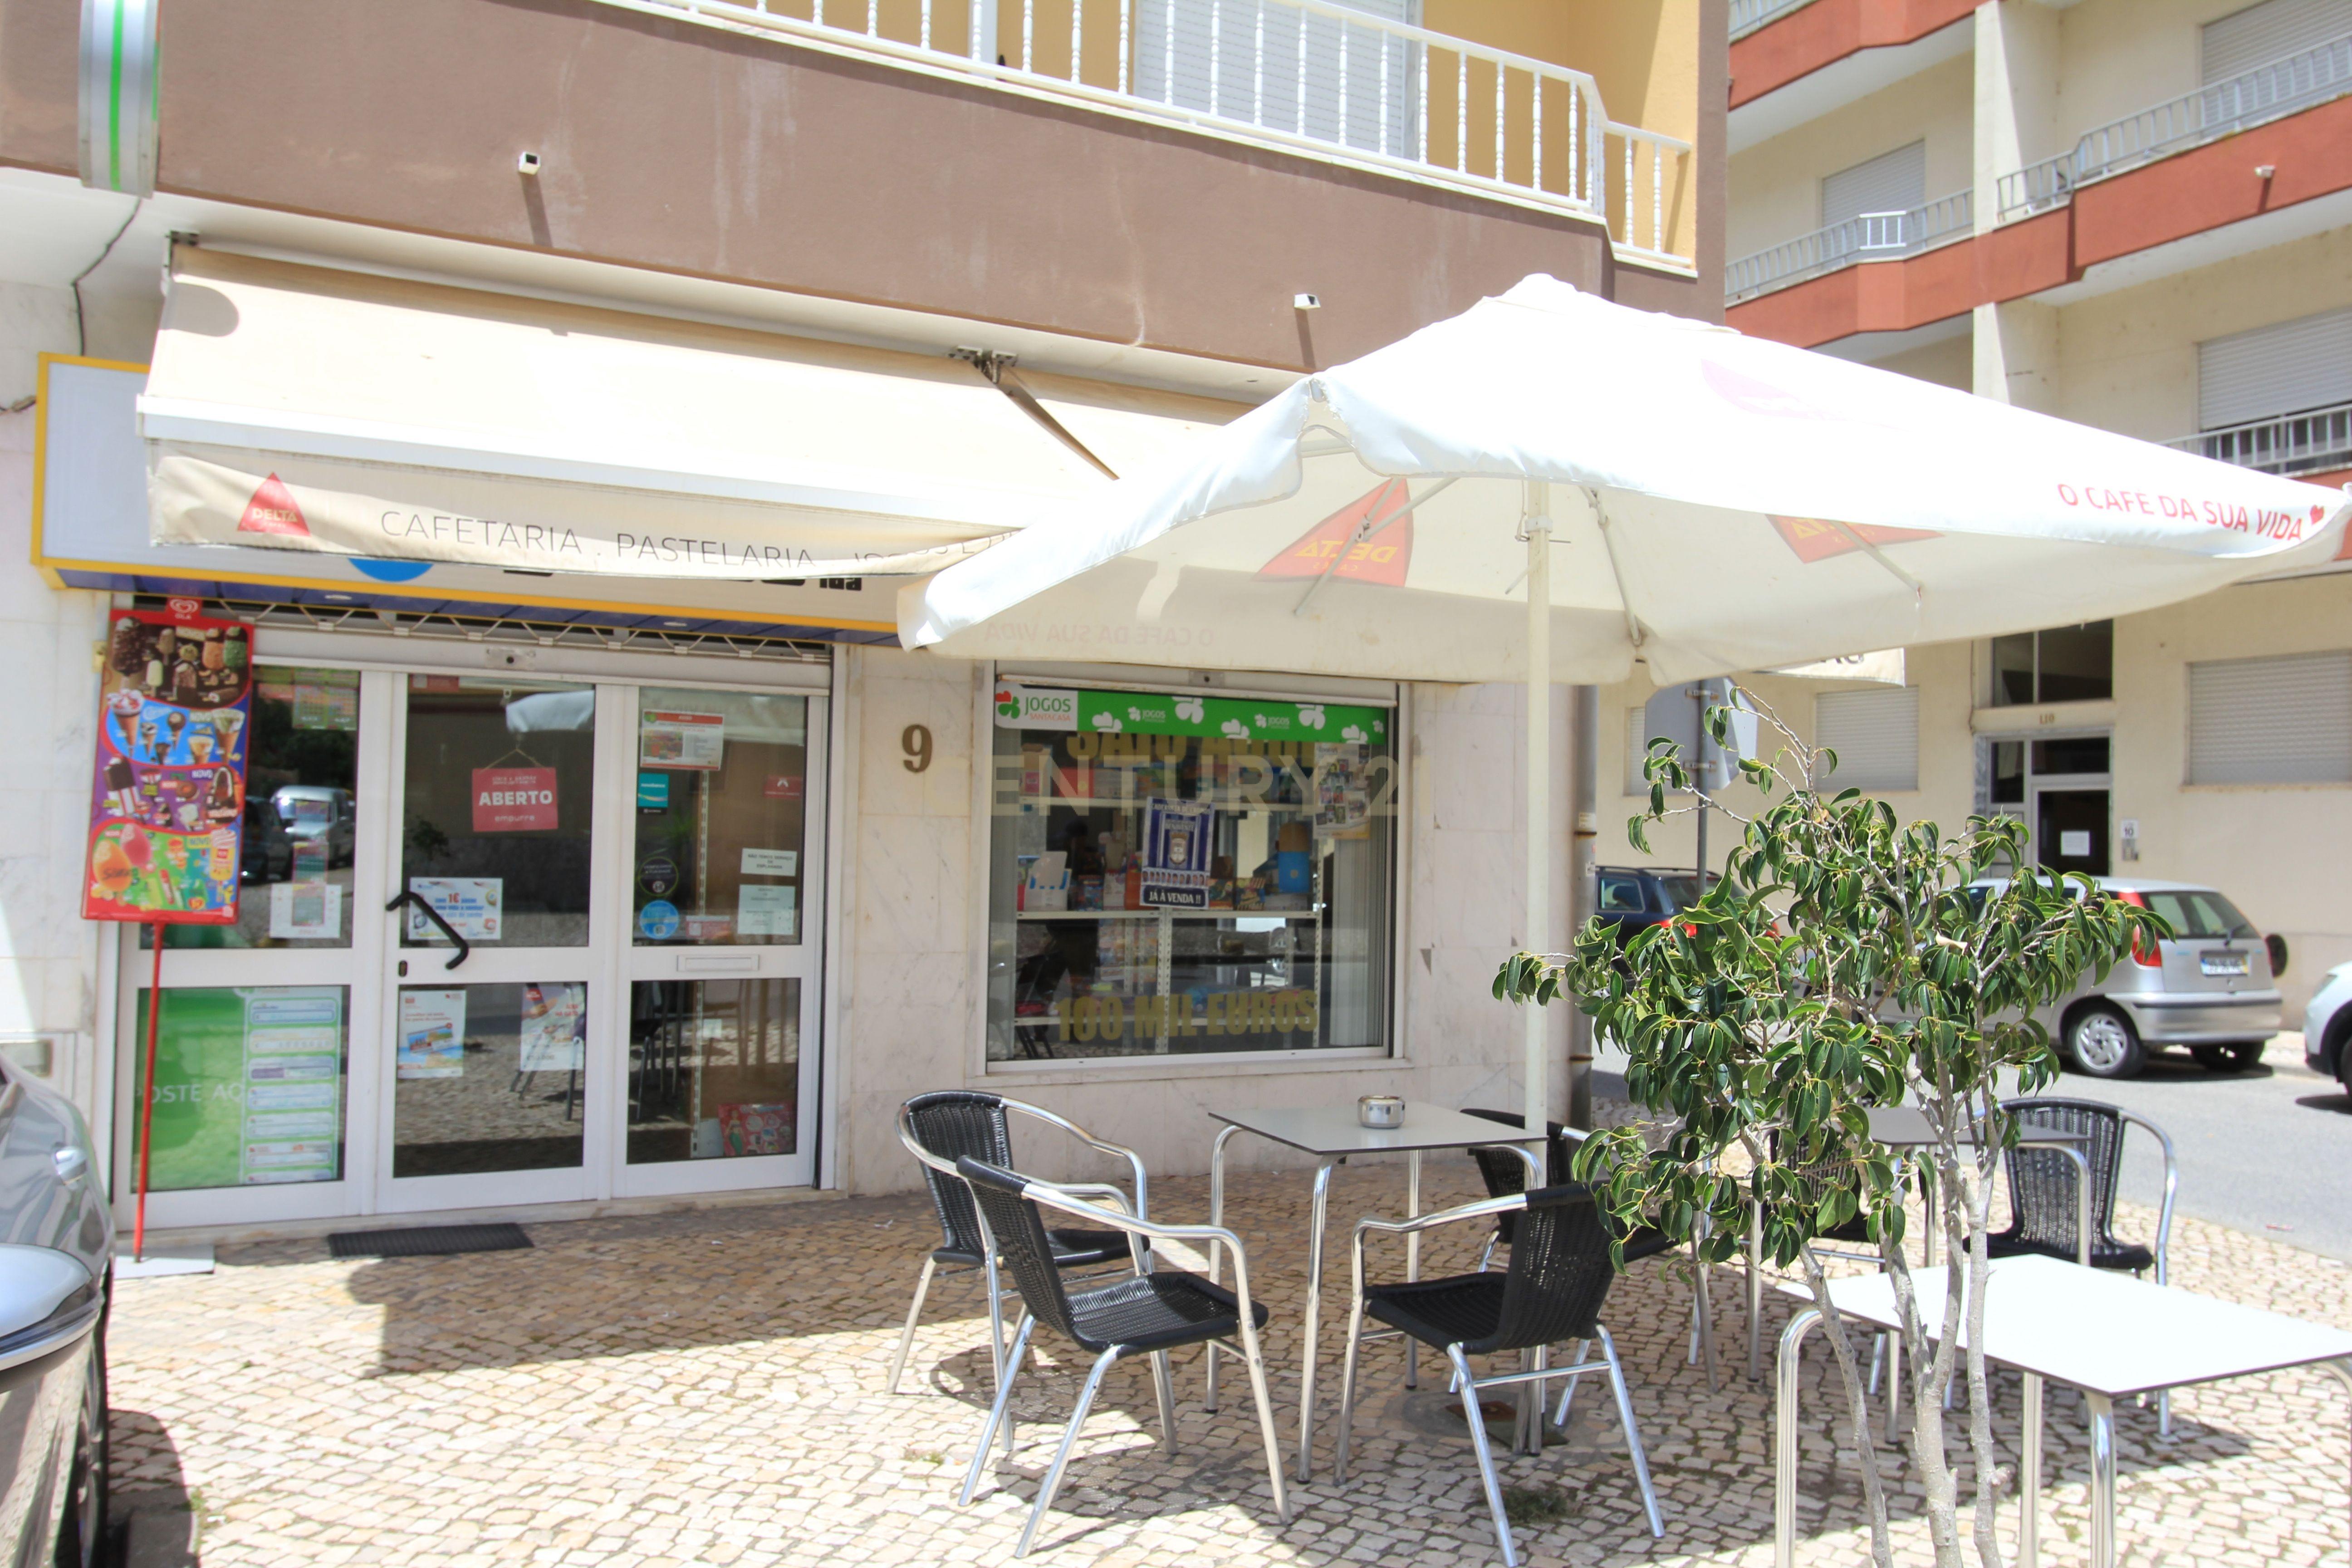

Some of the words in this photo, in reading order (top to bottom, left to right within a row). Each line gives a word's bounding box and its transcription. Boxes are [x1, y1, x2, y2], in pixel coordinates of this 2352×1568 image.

[252, 507, 299, 523] DELTA
[2058, 484, 2078, 506] O
[2158, 495, 2198, 522] DA
[2203, 500, 2248, 533] SUA
[2256, 508, 2303, 541] VIDA
[381, 510, 582, 554] CAFETARIA
[617, 533, 817, 568] PASTELARIA
[1024, 696, 1071, 715] JOGOS
[902, 724, 933, 773] 9
[479, 789, 553, 806] ABERTO
[1148, 889, 1159, 902] JÁ
[1167, 893, 1194, 904] VENDA
[1054, 996, 1124, 1042] 100
[1134, 994, 1197, 1038] MIL
[1206, 989, 1318, 1035] EUROS
